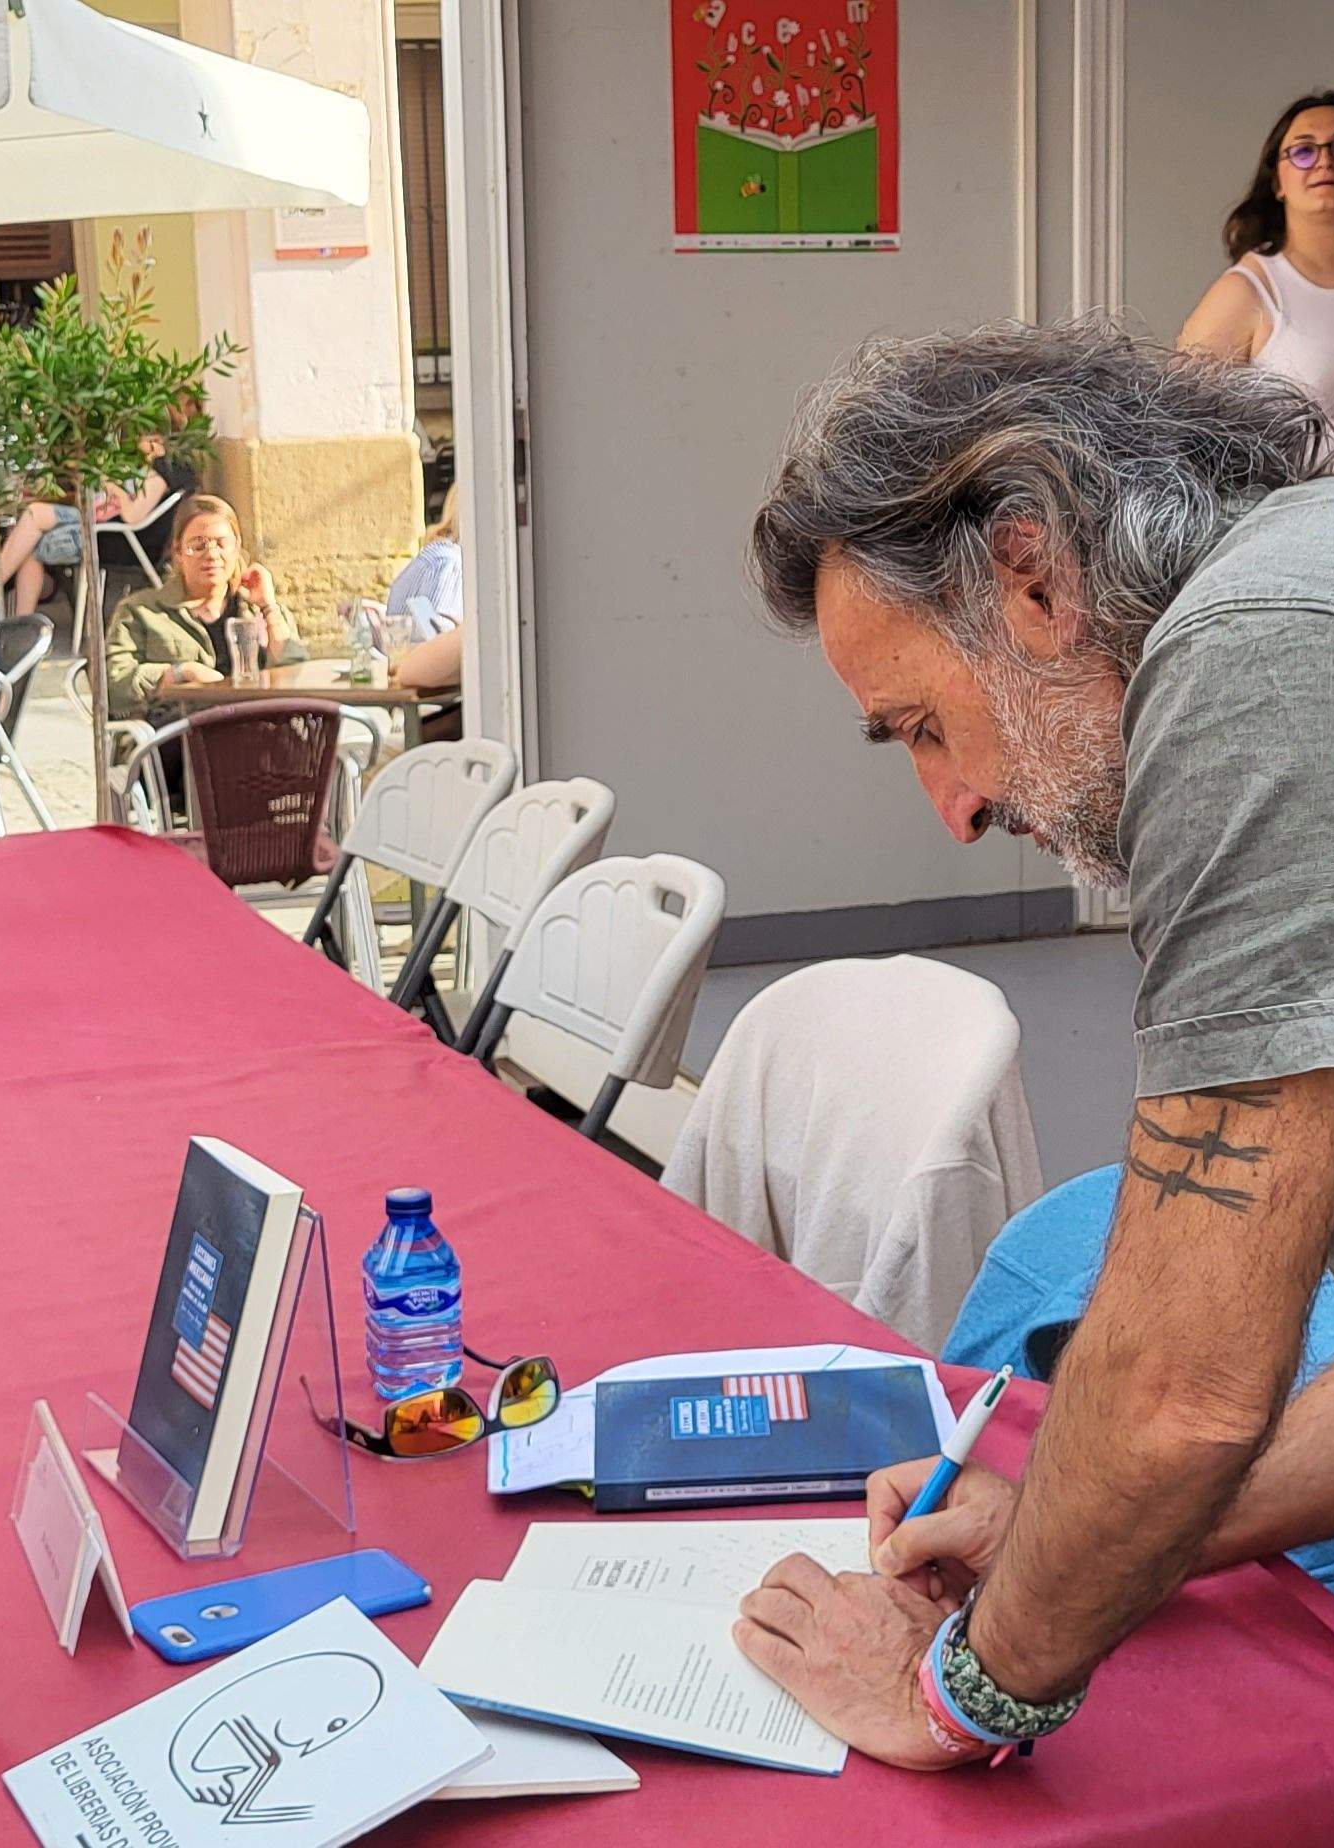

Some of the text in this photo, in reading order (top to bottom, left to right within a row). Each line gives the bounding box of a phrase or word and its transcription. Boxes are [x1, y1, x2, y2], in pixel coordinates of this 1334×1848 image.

[50, 1751, 77, 1776] DE
[81, 1736, 180, 1848] ASOCIACIÓN PROV
[62, 1767, 121, 1842] LIBRERIAS
